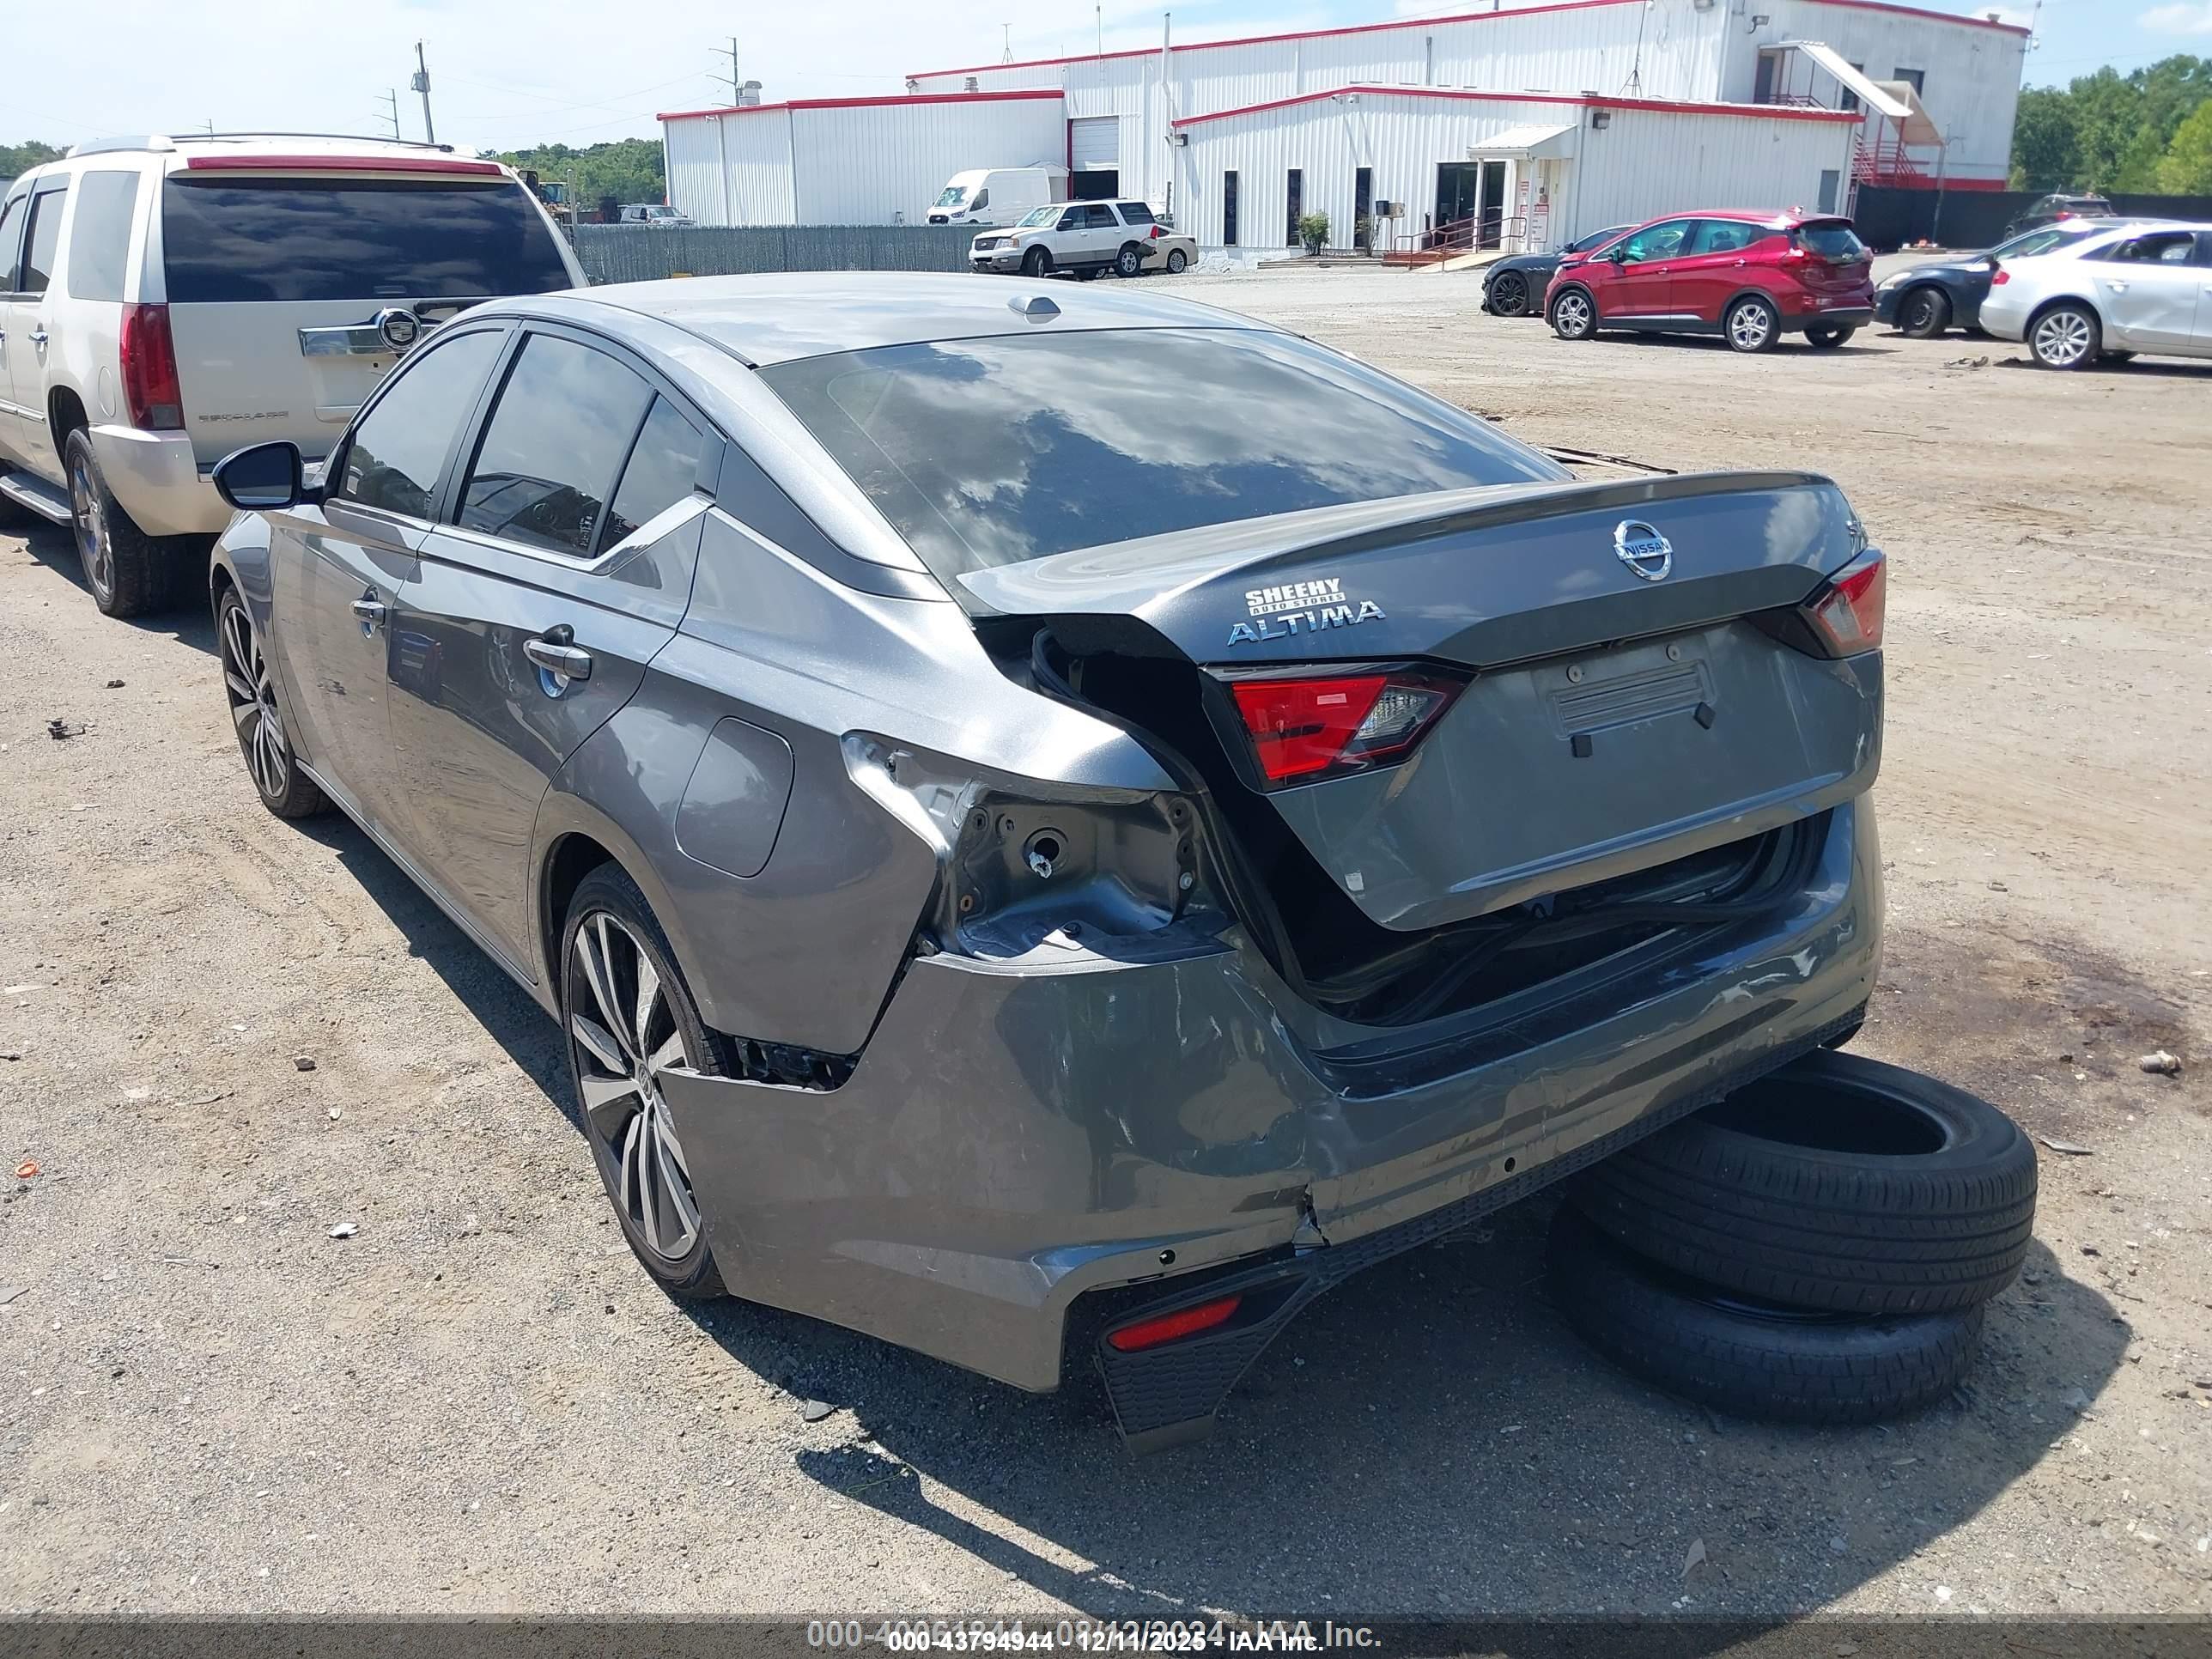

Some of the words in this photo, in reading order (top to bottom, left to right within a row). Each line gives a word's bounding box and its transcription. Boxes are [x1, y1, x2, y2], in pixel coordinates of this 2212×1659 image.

[1625, 541, 1669, 556] NISSAN
[1245, 578, 1340, 606] SHEEHY
[1253, 602, 1287, 614] AUTO
[1292, 594, 1343, 607] STORES
[1227, 600, 1387, 647] ALTIMA
